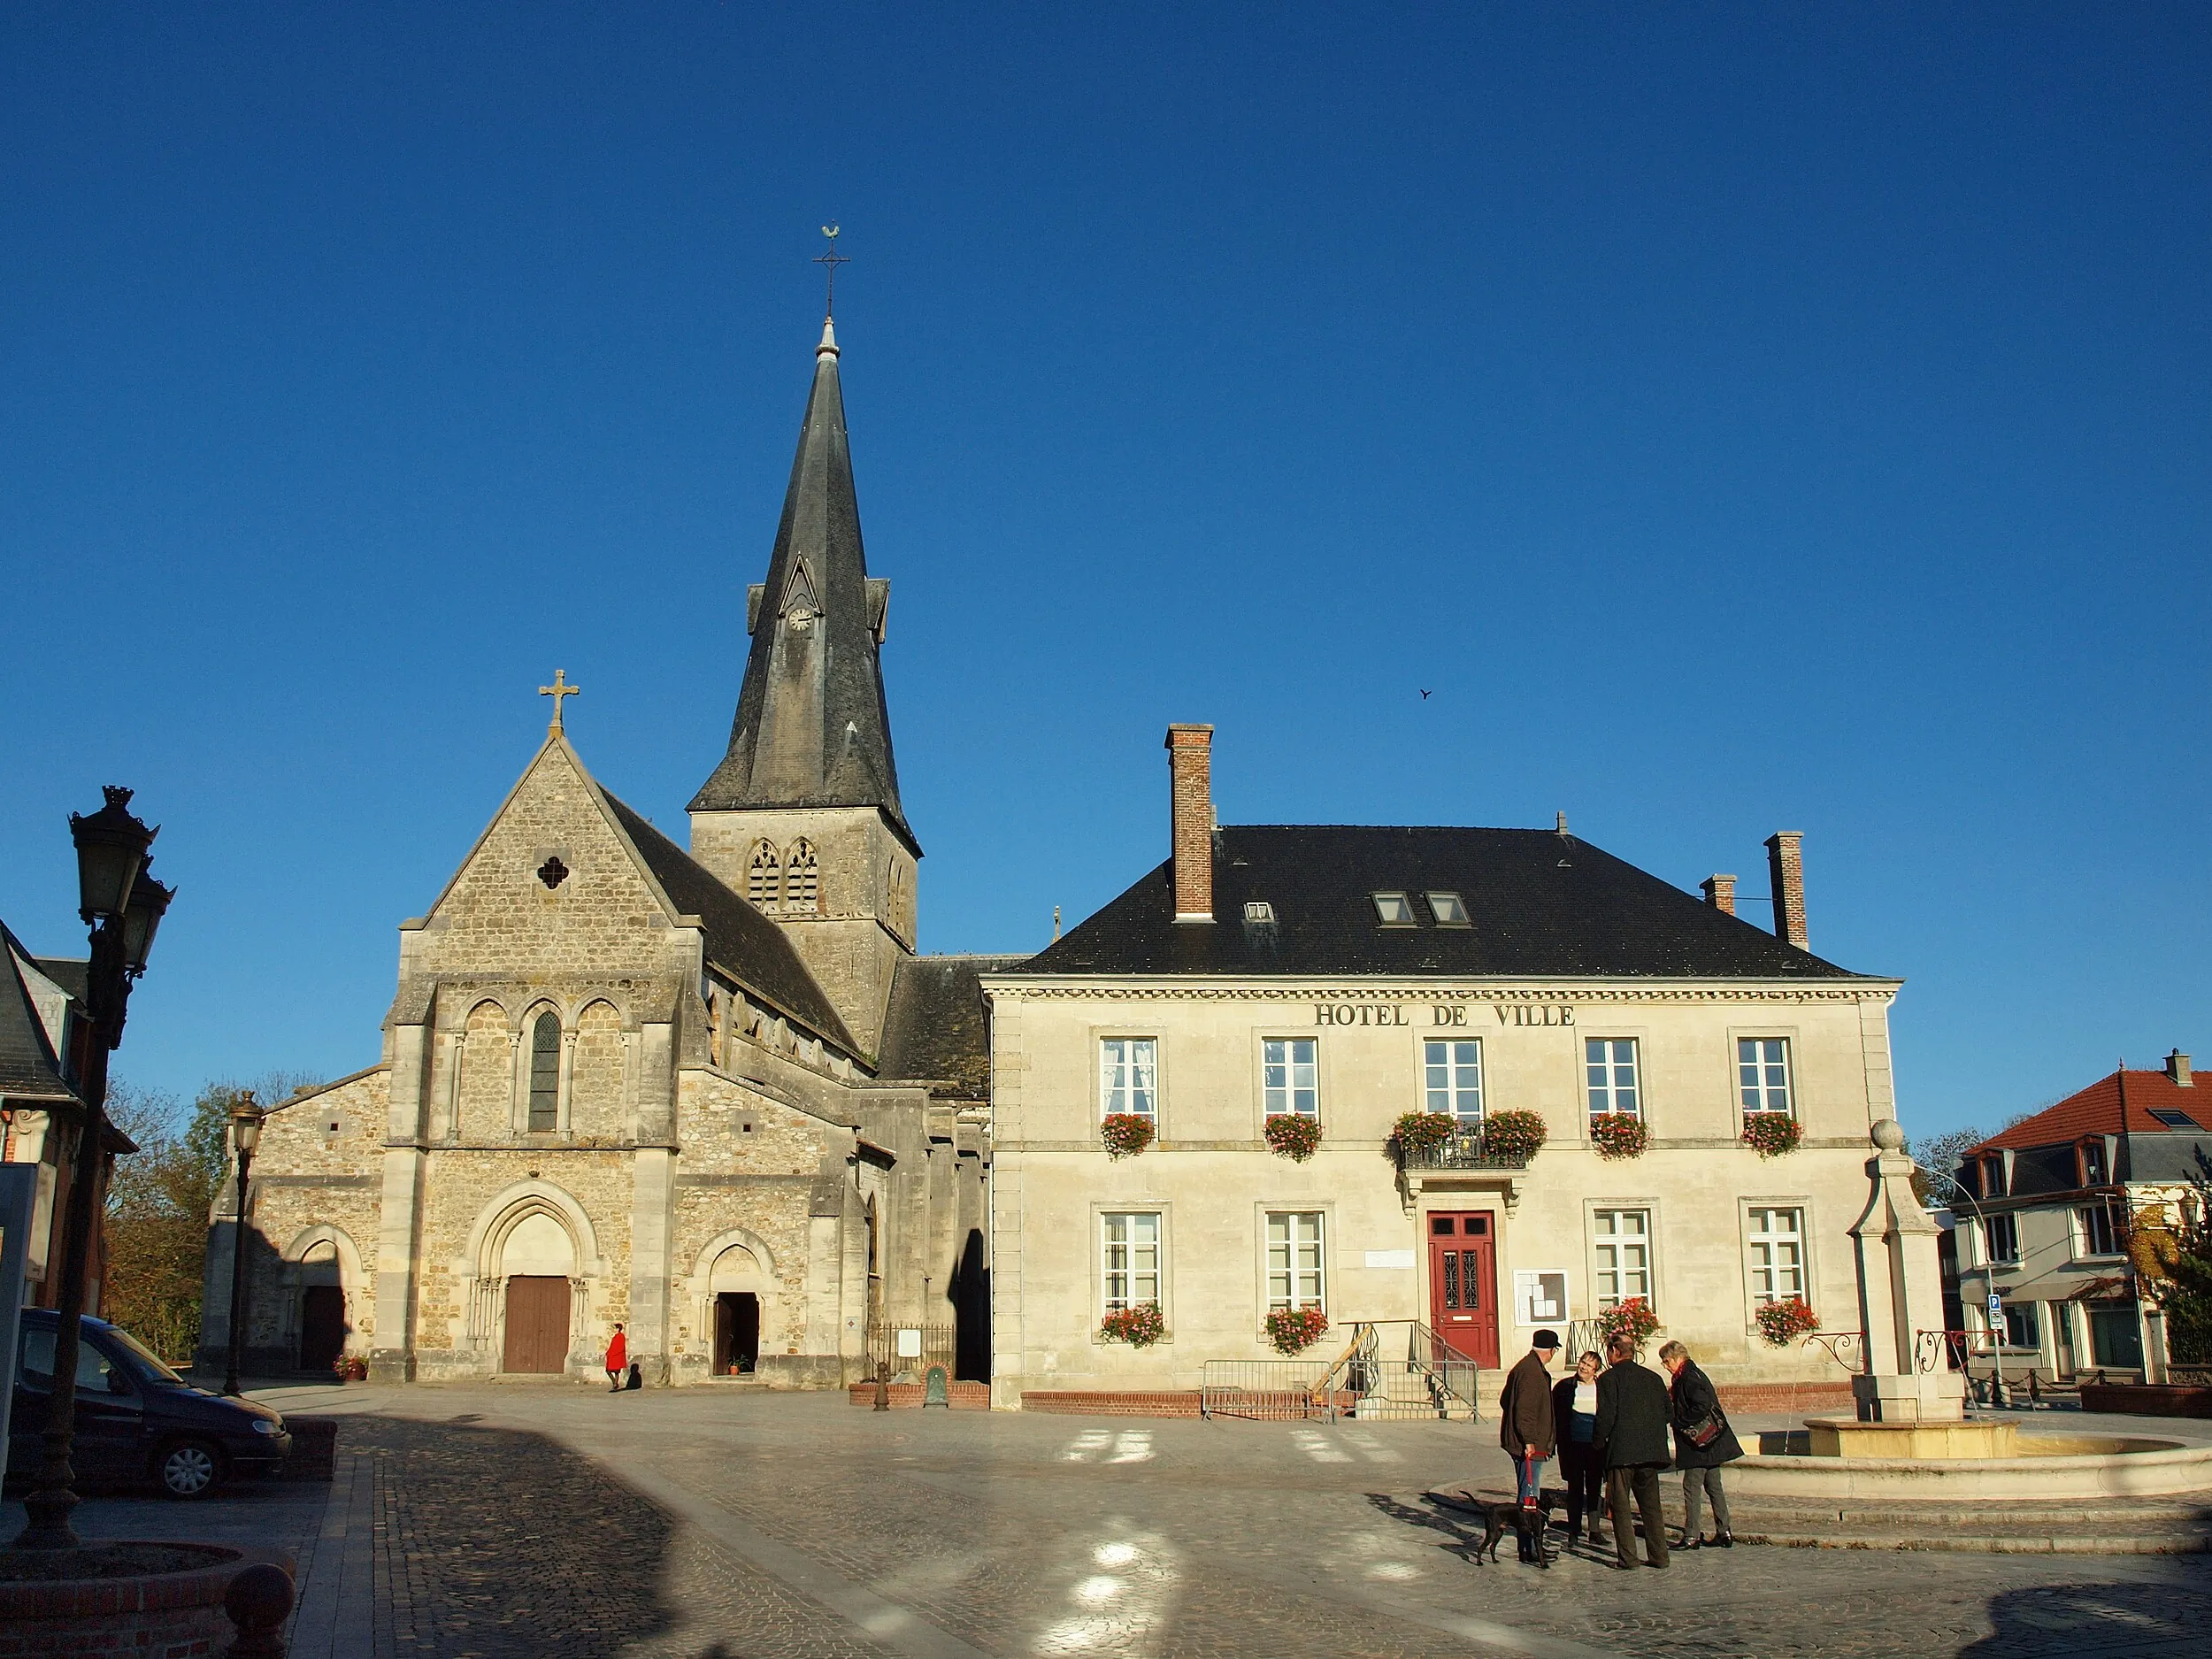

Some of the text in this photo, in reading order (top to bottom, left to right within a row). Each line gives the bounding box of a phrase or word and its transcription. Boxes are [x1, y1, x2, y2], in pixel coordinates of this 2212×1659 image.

[1314, 1003, 1576, 1026] HOTEL DE VILLE
[1992, 1297, 1998, 1308] P
